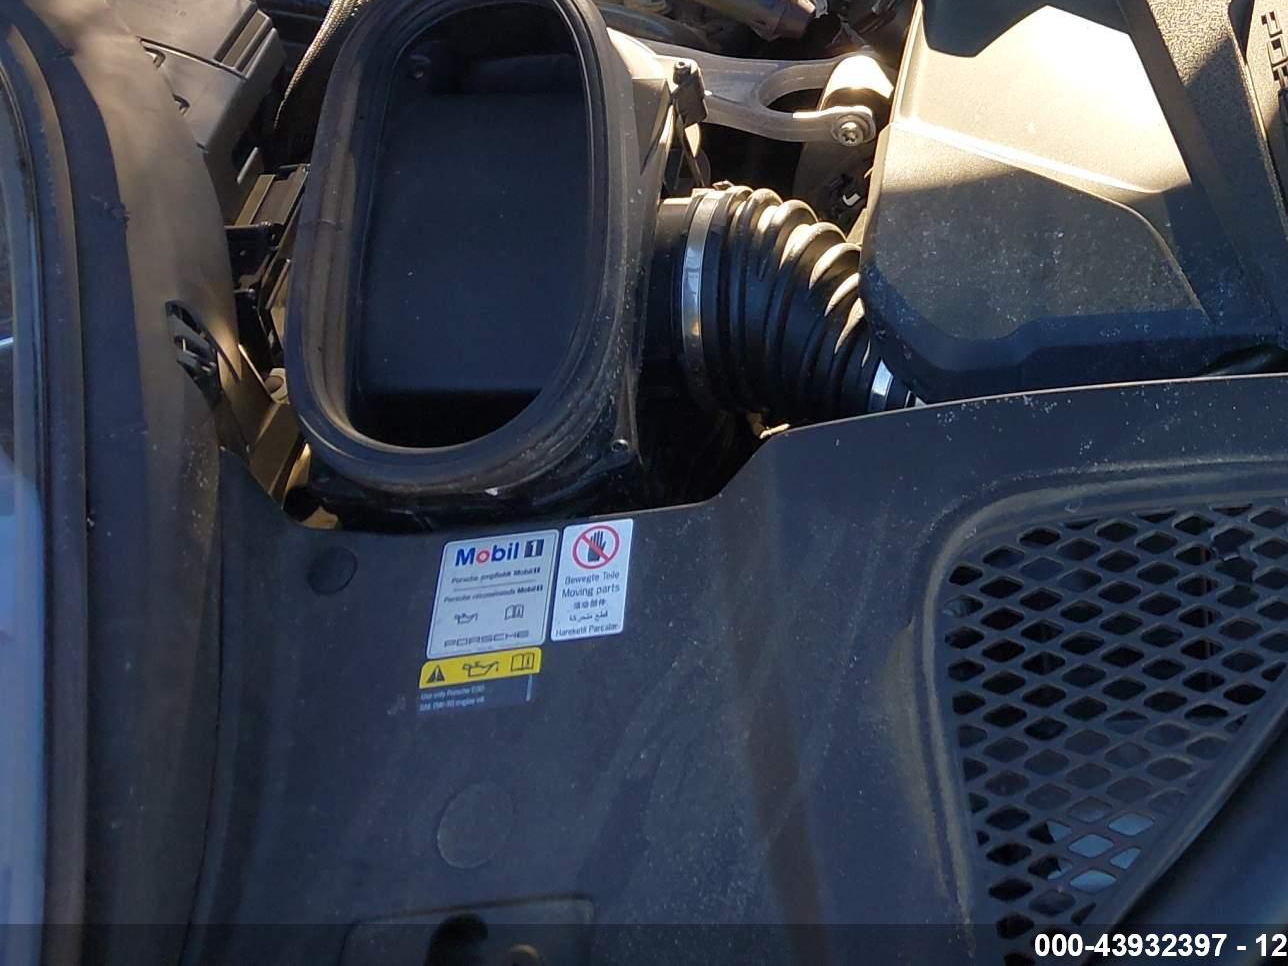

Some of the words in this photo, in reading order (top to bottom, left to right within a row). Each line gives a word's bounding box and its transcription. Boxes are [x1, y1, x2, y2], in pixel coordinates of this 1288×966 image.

[455, 541, 520, 567] Mobil
[564, 574, 600, 586] Bewegte
[561, 587, 594, 599] Moving
[596, 583, 621, 595] parts
[443, 629, 530, 648] PORSCHE
